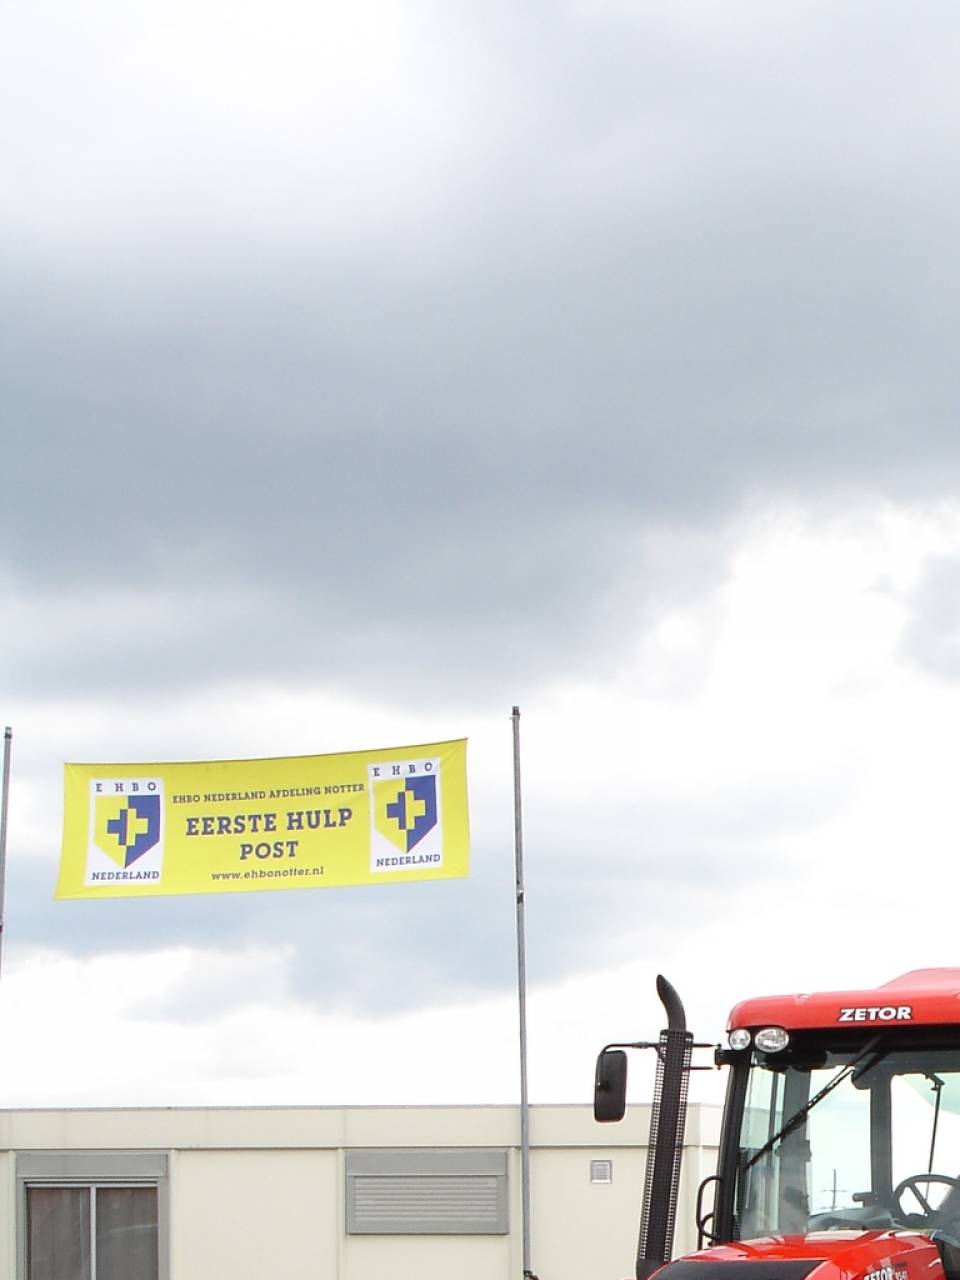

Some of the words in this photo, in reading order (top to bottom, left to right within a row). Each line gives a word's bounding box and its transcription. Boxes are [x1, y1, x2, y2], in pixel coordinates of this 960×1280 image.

[173, 794, 200, 804] EHBO
[204, 791, 265, 802] NEDERLAND
[269, 787, 321, 798] AFDELING
[324, 784, 365, 794] NOTTER
[186, 813, 277, 836] EERSTE
[286, 808, 353, 831] HULP
[240, 841, 298, 861] POST
[376, 854, 440, 867] NEDERLAND
[91, 871, 160, 881] NEDERLAND
[838, 1006, 912, 1021] ZETOR
